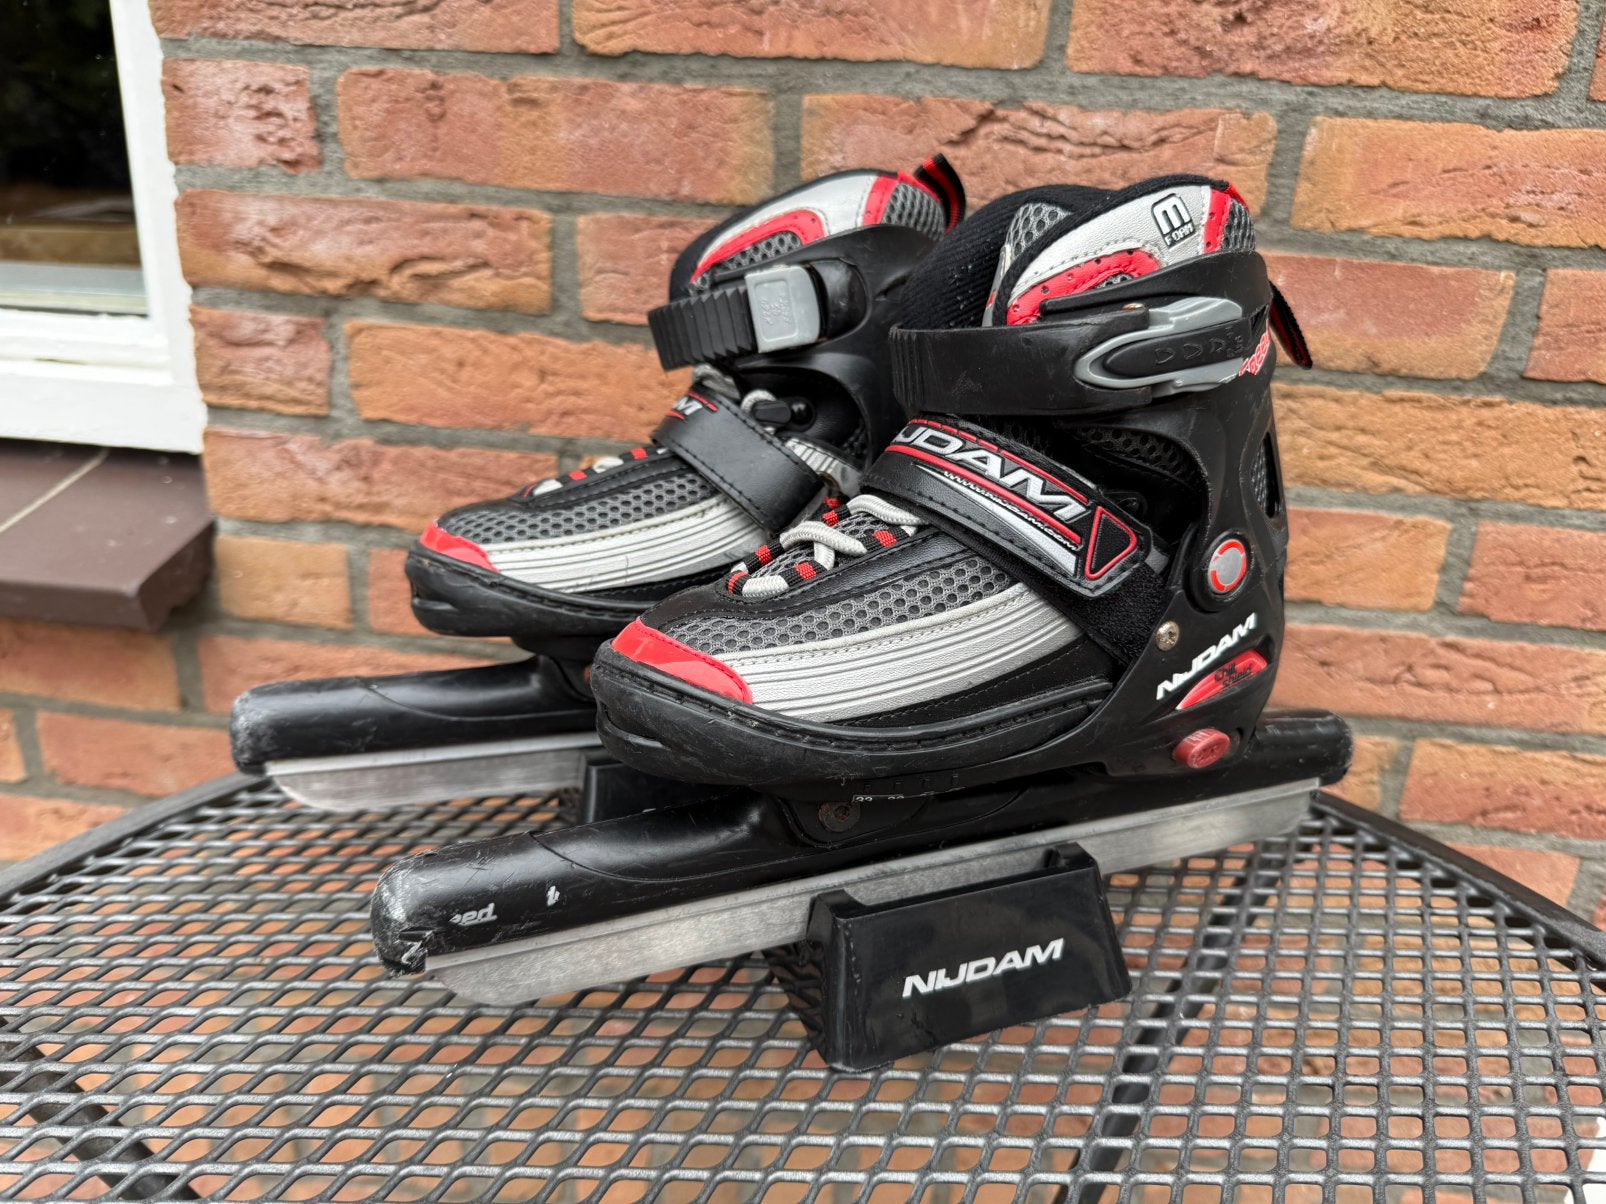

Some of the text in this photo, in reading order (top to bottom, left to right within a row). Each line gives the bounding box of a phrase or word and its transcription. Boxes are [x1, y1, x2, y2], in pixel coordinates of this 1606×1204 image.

[943, 470, 1078, 551] WWW.NIJDAM.COM
[1156, 612, 1257, 700] NIJDAM
[902, 938, 1065, 998] NIJDAM
